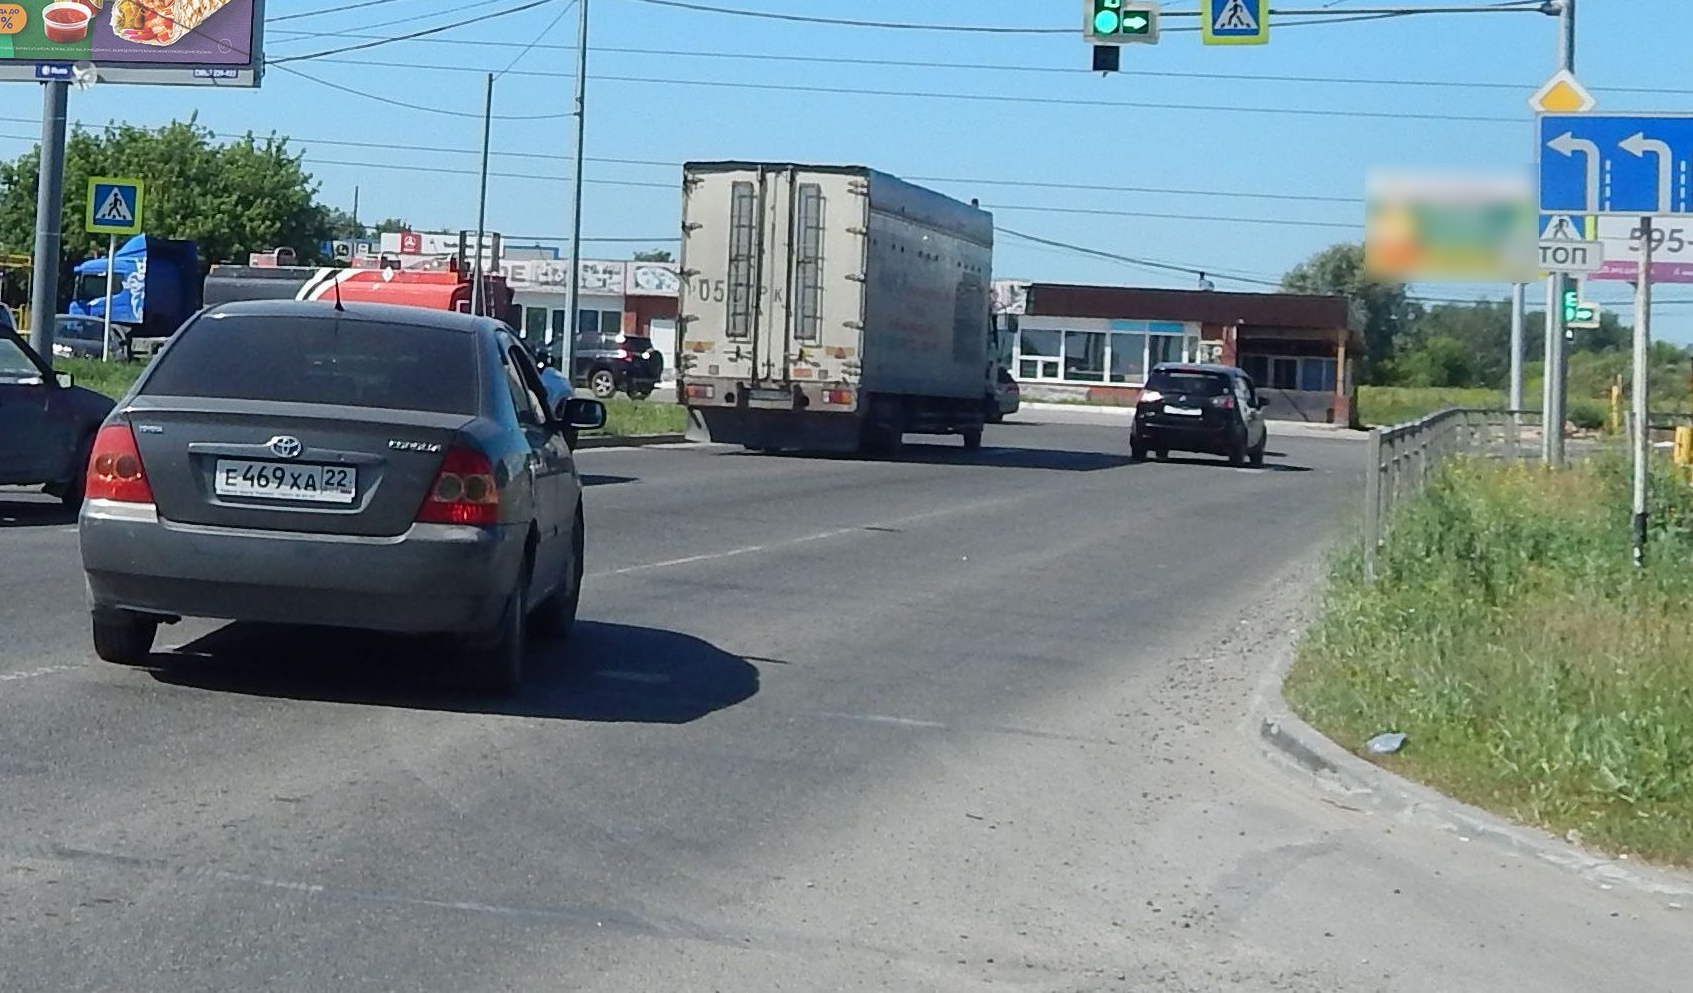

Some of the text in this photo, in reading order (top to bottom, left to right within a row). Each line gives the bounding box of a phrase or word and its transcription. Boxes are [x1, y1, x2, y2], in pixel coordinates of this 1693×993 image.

[1539, 246, 1587, 264] ТОП
[224, 464, 348, 492] Е469ХА 22
